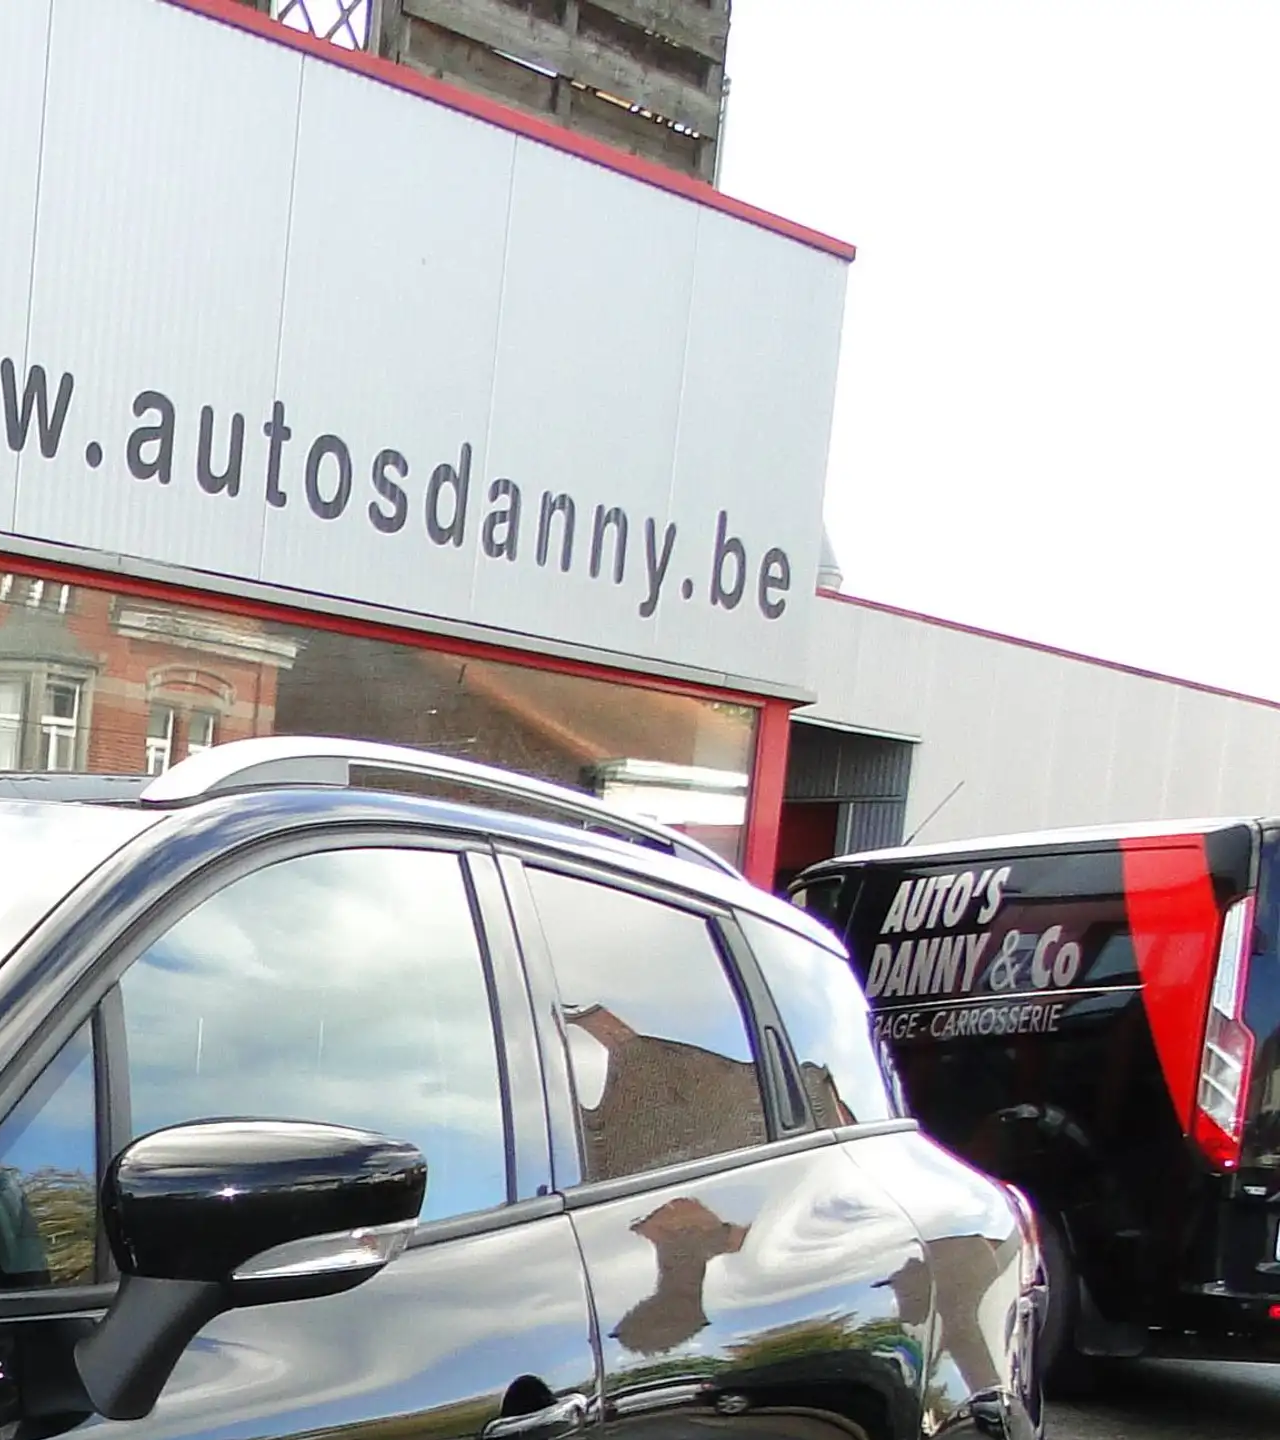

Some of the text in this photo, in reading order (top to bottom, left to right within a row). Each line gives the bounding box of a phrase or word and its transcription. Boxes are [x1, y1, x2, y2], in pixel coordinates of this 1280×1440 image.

[880, 867, 1012, 935] AUTO'S
[866, 931, 988, 999] DANNY
[930, 1004, 1064, 1038] CARROSSERIE
